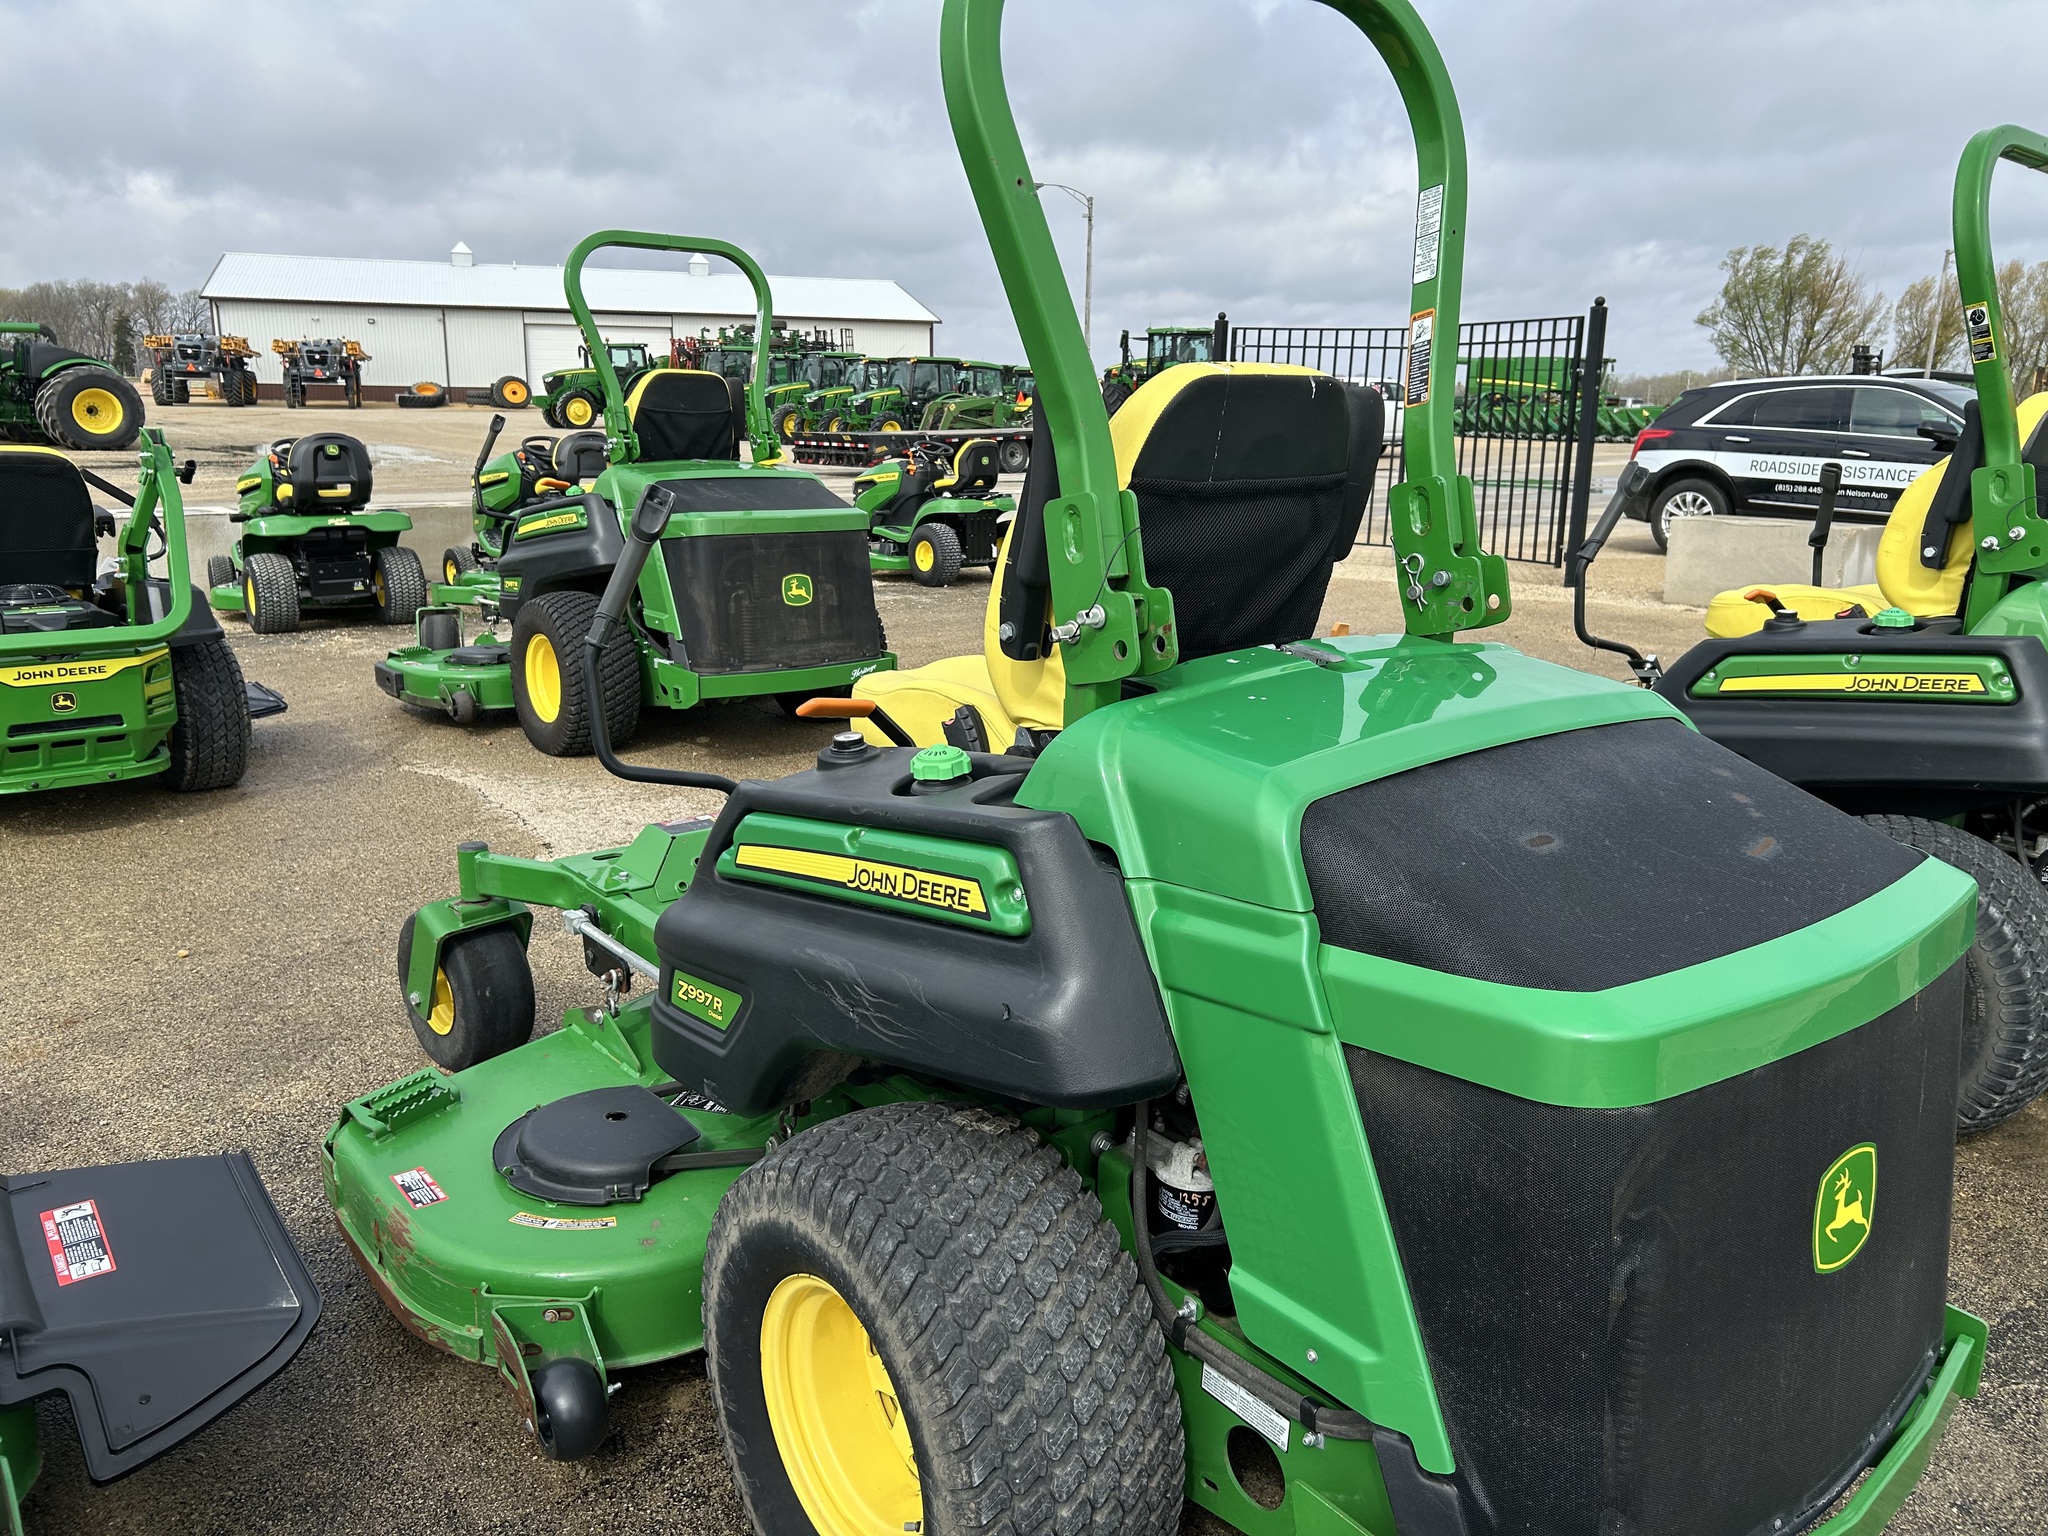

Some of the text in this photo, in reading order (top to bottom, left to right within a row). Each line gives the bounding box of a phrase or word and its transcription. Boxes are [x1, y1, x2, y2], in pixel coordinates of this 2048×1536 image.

[1750, 459, 1918, 483] ROADSIDE SISTANCE
[1775, 483, 1793, 493] (815)
[1846, 489, 1871, 498] Nelson
[1871, 490, 1889, 500] Auto
[545, 515, 575, 528] JOHN DEERE
[13, 665, 107, 681] JOHN DEERE
[1845, 676, 1971, 691] JOHN DEERE
[847, 863, 971, 909] JOHN DEERE
[677, 979, 723, 1013] Z997R
[1179, 1192, 1211, 1207] 1255
